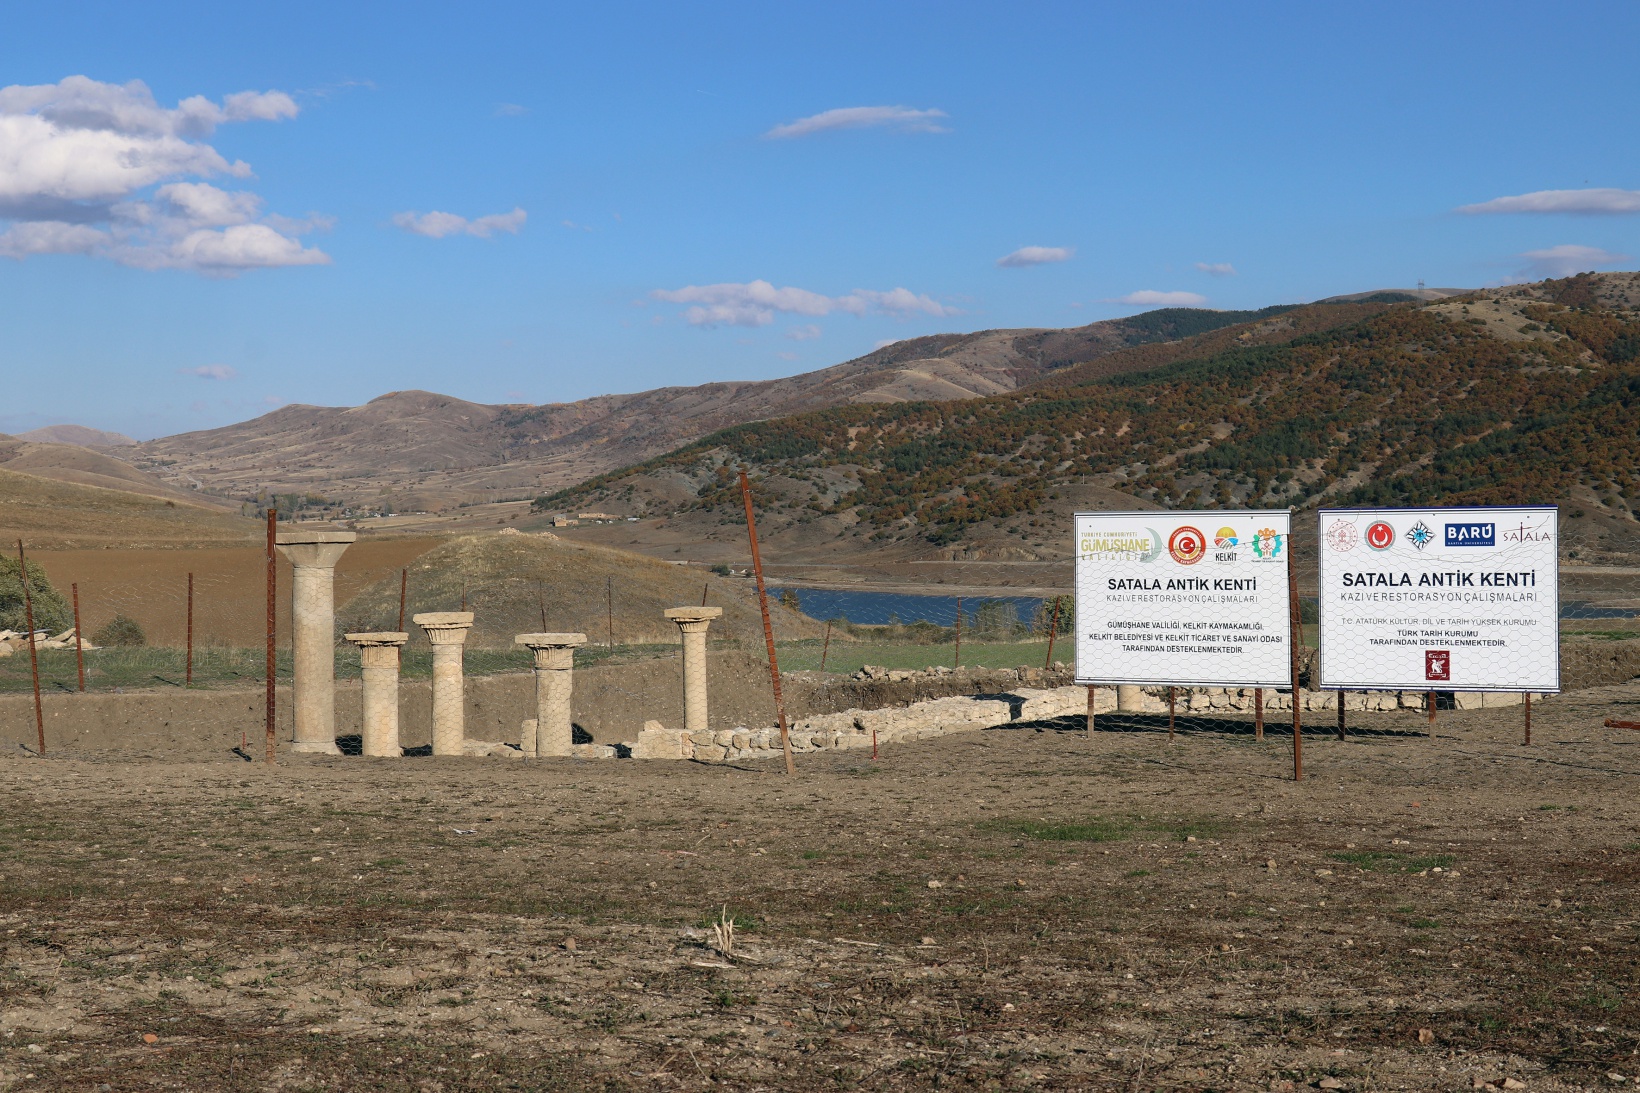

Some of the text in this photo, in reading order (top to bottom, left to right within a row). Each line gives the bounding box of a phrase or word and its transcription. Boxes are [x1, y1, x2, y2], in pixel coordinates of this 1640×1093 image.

[1081, 538, 1150, 553] GÜMÜŞHANE
[1215, 551, 1238, 562] KELKİT
[1108, 576, 1256, 590] SATALA ANTİK KENTİ
[1343, 570, 1535, 586] SATALA ANTİK KENTİ
[1202, 595, 1258, 604] ÇALIŞMALARI
[1340, 592, 1537, 603] KAZI VE RESTORASYON ÇALIŞMALARI
[1108, 621, 1150, 629] GÜMÜŞHANE
[1089, 632, 1112, 640] KELKİT
[1114, 632, 1153, 640] BELEDİYESİ
[1233, 634, 1259, 642] SANAYİ
